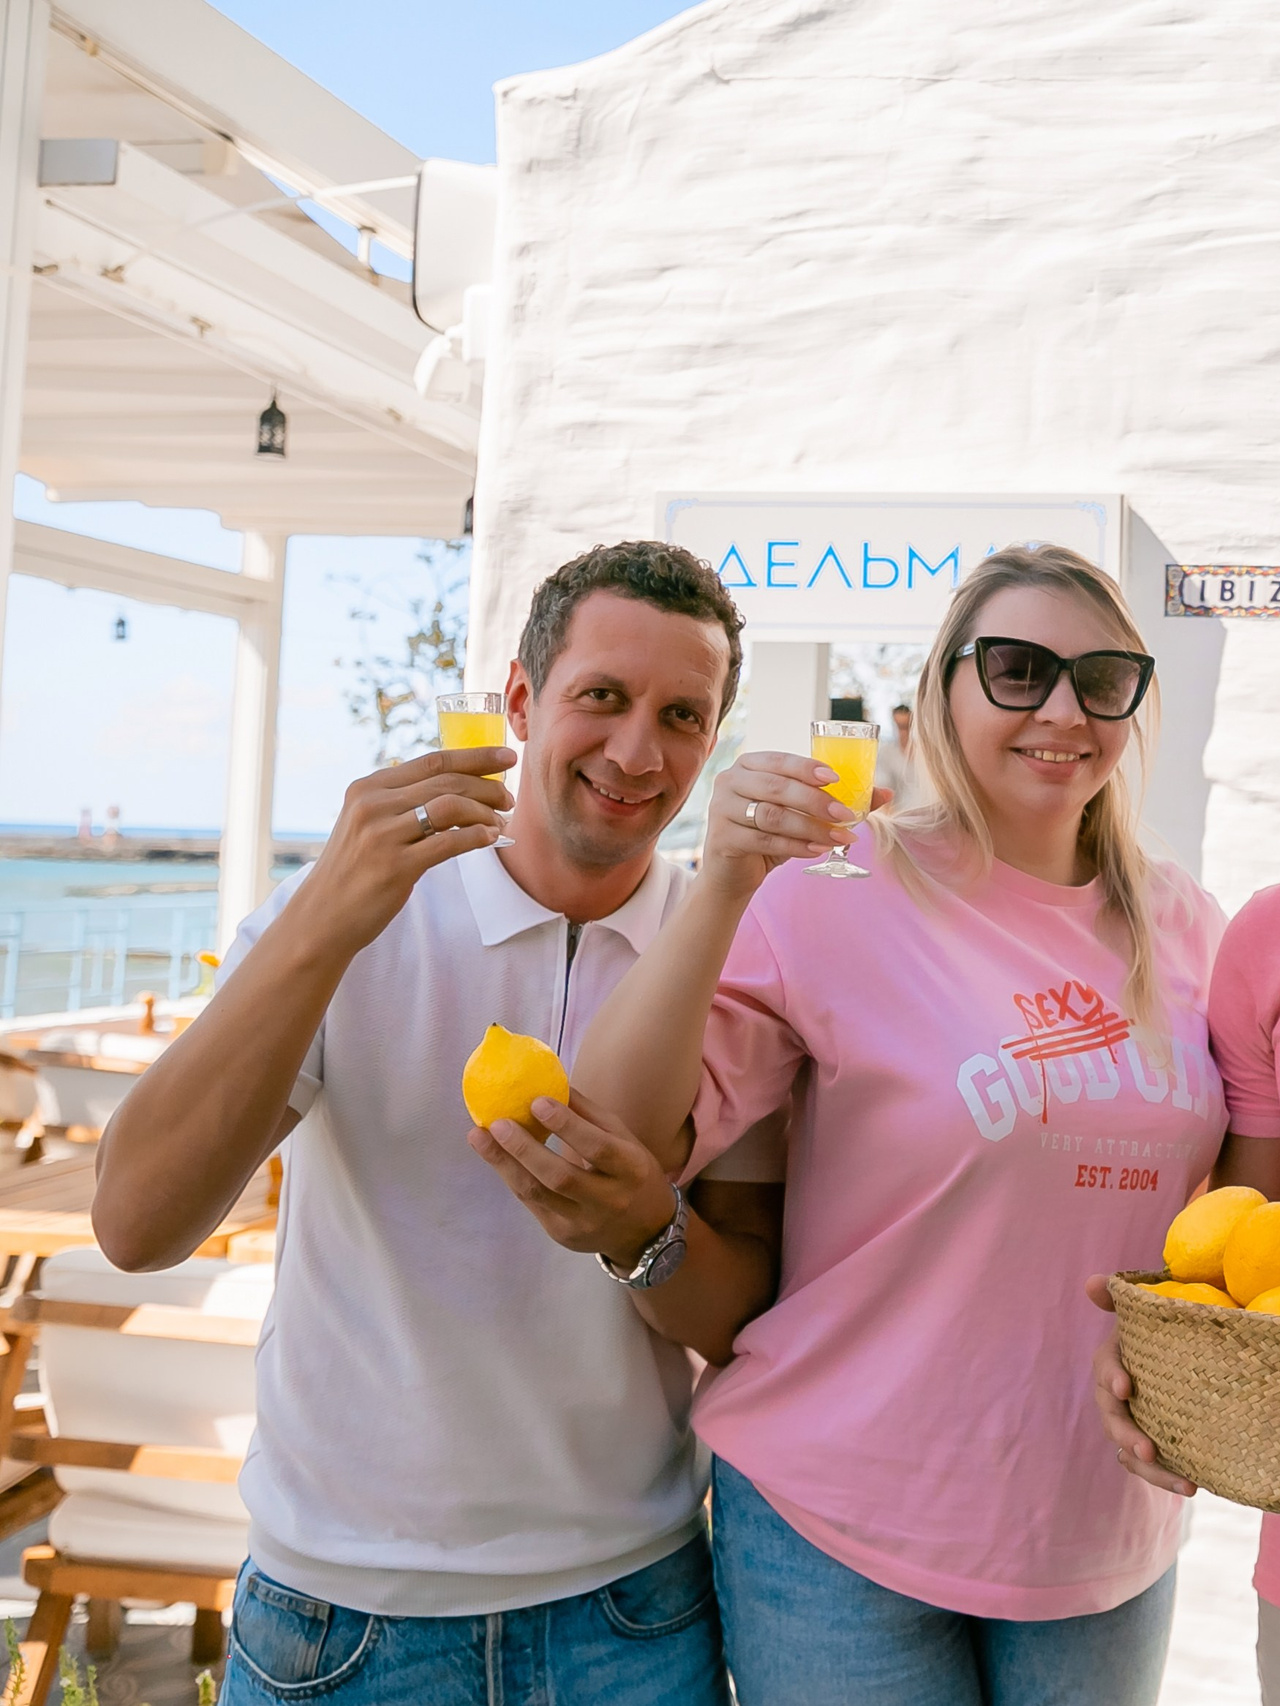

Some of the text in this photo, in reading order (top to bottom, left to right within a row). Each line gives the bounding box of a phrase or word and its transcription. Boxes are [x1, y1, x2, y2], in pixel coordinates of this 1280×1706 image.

[717, 541, 1037, 590] ДЕЛЬМ
[1013, 979, 1104, 1029] SEXY
[956, 1033, 1121, 1142] GOOD
[1040, 1132, 1083, 1152] VERY
[1074, 1164, 1159, 1191] EST. 2004
